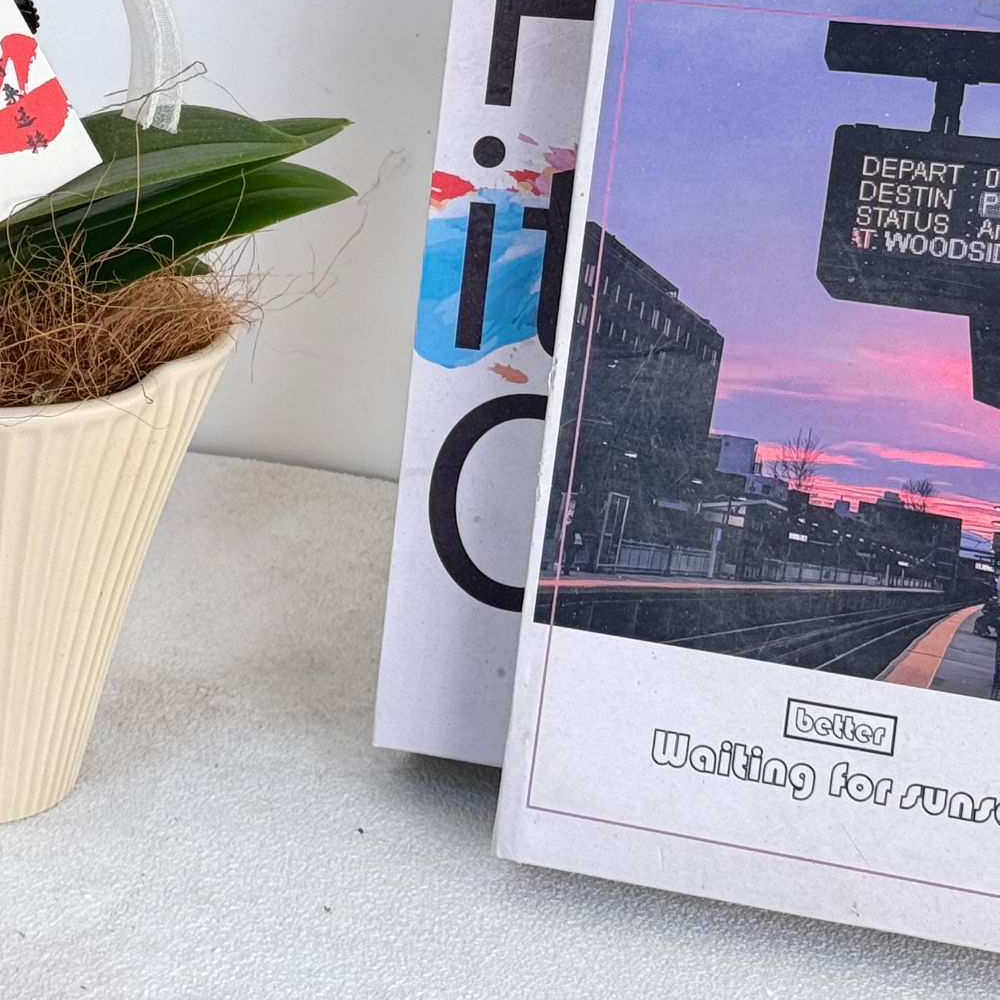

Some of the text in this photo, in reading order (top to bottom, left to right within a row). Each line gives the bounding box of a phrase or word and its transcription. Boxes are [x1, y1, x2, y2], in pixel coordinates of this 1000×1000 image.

[862, 156, 965, 185] DEPART
[859, 180, 954, 210] DESTIN
[856, 205, 949, 235] STATUS
[795, 707, 886, 746] better
[651, 729, 1000, 826] Waiting for suns
